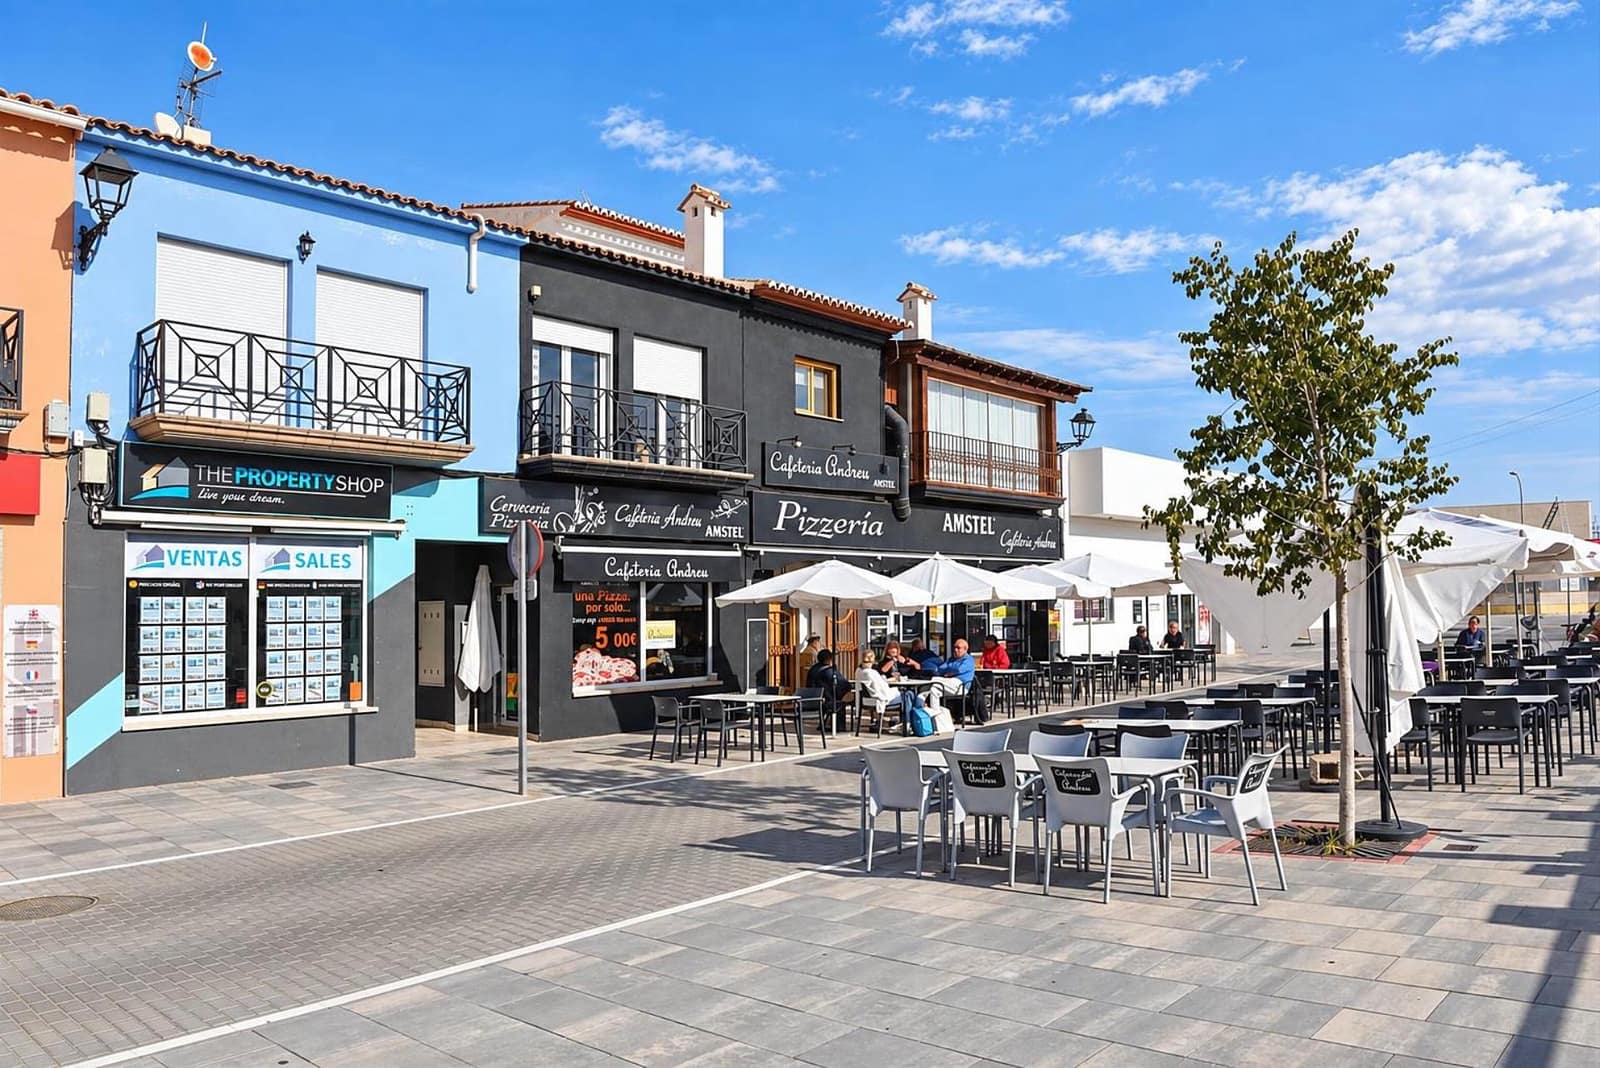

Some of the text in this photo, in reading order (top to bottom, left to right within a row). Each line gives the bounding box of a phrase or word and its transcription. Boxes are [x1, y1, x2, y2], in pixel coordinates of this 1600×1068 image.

[770, 451, 870, 480] Cafeteria Andreu
[198, 487, 219, 500] Live
[490, 494, 550, 514] Cerveceria
[615, 504, 702, 529] Cafeteria Andreu
[772, 500, 884, 539] Pizzería
[943, 512, 995, 535] AMSTEL
[705, 525, 744, 538] AMSTEL
[167, 549, 242, 567] VENTAS
[295, 552, 351, 569] SALES
[604, 556, 709, 581] Cafeteria Andreu
[585, 603, 601, 615] por
